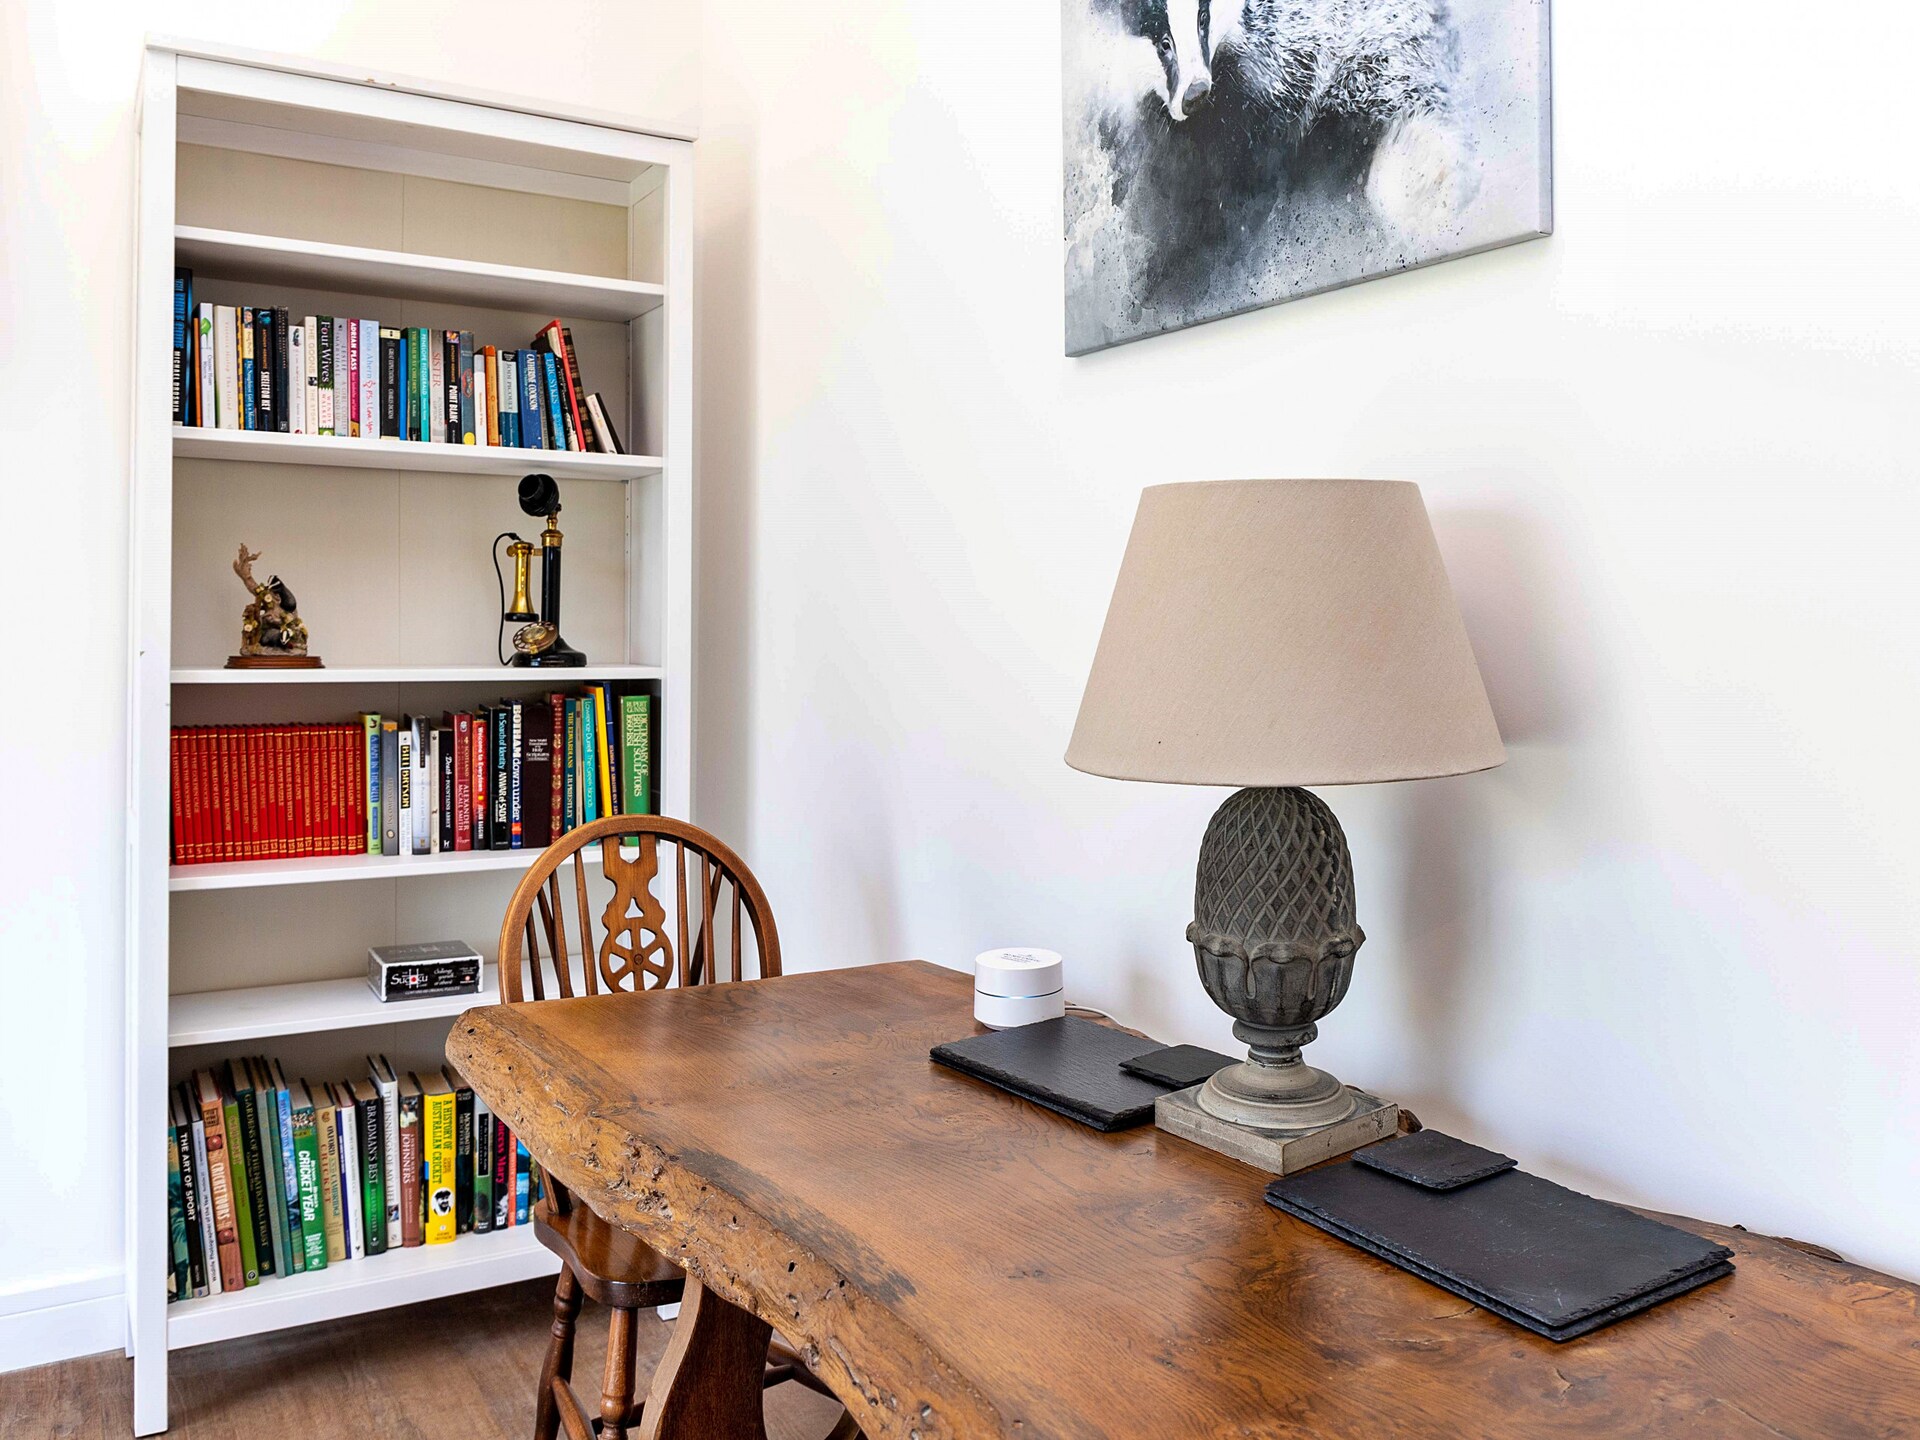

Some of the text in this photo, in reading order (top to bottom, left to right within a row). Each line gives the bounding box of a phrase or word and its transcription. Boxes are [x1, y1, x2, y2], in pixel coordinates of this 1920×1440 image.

[320, 321, 332, 382] Four Wives
[432, 352, 441, 387] SISTER
[260, 371, 270, 399] SKELETON
[449, 385, 458, 403] POINT
[546, 359, 559, 404] ERIC SYKES
[261, 399, 270, 411] KEY
[449, 404, 458, 423] BLANC
[499, 720, 507, 739] Search
[513, 705, 522, 757] BOTHAM
[640, 714, 648, 764] DICTIONARY
[498, 746, 507, 769] Identity
[633, 714, 642, 797] BRITISH SCULPTORS
[402, 746, 410, 808] BILL BRYSON
[499, 803, 507, 822] SADAT
[327, 1126, 336, 1155] OXFORD
[366, 1105, 378, 1161] BRADMAN'S
[432, 1101, 442, 1184] AUSTRALIAN CRICKET
[444, 1108, 452, 1140] HISTORY
[180, 1133, 196, 1221] THE ART OF SPORT
[245, 1094, 256, 1139] GARDENS
[252, 1169, 264, 1220] NATIONAL
[259, 1222, 269, 1247] TRUST
[298, 1150, 313, 1192] CRICKET
[321, 1144, 331, 1204] CRICKET
[368, 1164, 378, 1184] BEST
[402, 1134, 410, 1184] JOHNNERS
[496, 1156, 506, 1183] Mary
[211, 1162, 229, 1219] CRICKET TOURS
[303, 1195, 315, 1221] YEAR
[206, 1223, 216, 1260] Photographer
